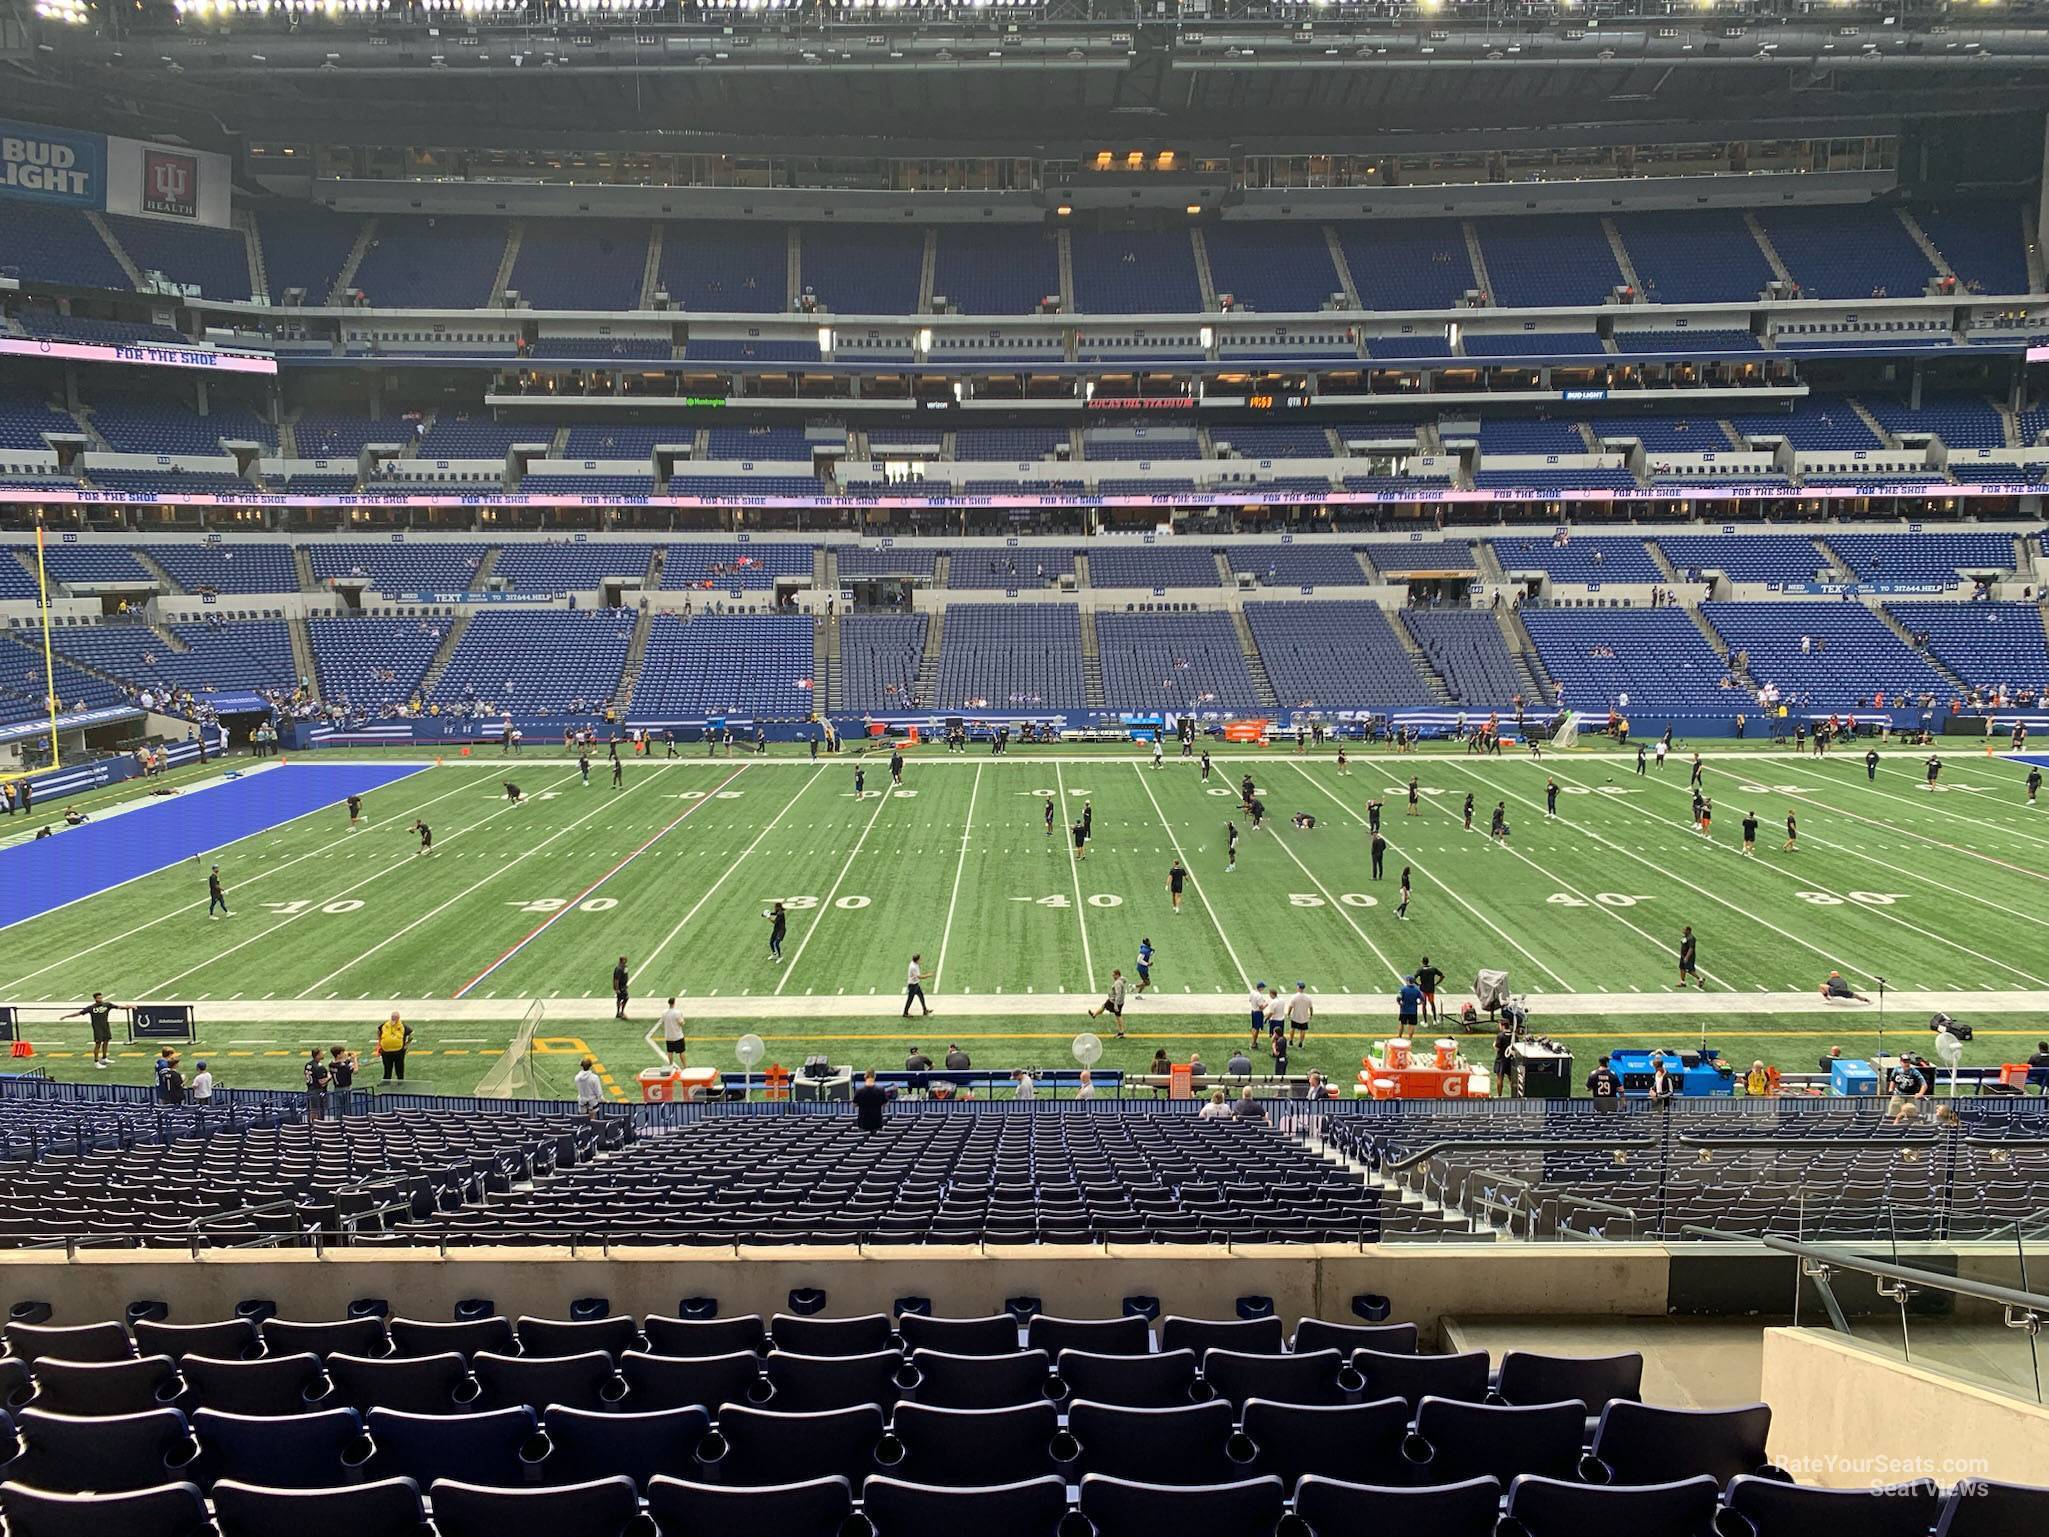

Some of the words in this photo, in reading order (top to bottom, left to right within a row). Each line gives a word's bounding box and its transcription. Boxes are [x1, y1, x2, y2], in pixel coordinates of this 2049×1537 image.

[2, 137, 75, 168] BUD
[0, 162, 89, 195] IGHT
[147, 200, 193, 215] HEALTH
[116, 348, 144, 361] FOR
[148, 351, 177, 363] THE
[181, 354, 217, 366] SHOE
[1583, 391, 1604, 400] LIGHT
[926, 401, 948, 410] verizon
[1613, 489, 1633, 498] FOR
[1635, 489, 1654, 498] THE
[1656, 489, 1681, 498] SHOE
[1732, 487, 1751, 496] FOR
[1754, 487, 1774, 496] THE
[1776, 487, 1801, 496] SHOE
[1856, 485, 1875, 495] FOR
[1877, 485, 1898, 495] THE
[1901, 485, 1927, 495] SHOE
[1981, 484, 2001, 494] FOR
[2003, 484, 2024, 494] THE
[78, 493, 100, 502] FOR
[104, 493, 126, 502] THE
[129, 493, 158, 502] SHOE
[1152, 495, 1169, 503] FOR
[1171, 495, 1190, 503] THE
[1192, 495, 1216, 503] SHOE
[1263, 493, 1281, 502] FOR
[1283, 493, 1301, 502] THE
[1304, 493, 1327, 502] SHOE
[1377, 491, 1396, 500] FOR
[1398, 491, 1417, 500] THE
[1419, 491, 1444, 500] SHOE
[1493, 490, 1512, 499] FOR
[1515, 490, 1534, 499] THE
[1536, 490, 1561, 499] SHOE
[216, 496, 237, 504] FOR
[239, 496, 259, 504] THE
[261, 496, 287, 504] SHOE
[339, 496, 359, 504] FOR
[361, 496, 381, 504] THE
[383, 496, 409, 504] SHOE
[461, 496, 481, 504] FOR
[483, 496, 503, 504] THE
[505, 496, 530, 504] SHOE
[581, 496, 601, 504] FOR
[603, 496, 622, 504] THE
[624, 496, 649, 504] SHOE
[700, 497, 718, 505] FOR
[720, 497, 740, 505] THE
[742, 497, 766, 505] SHOE
[815, 497, 832, 505] FOR
[835, 497, 853, 505] THE
[855, 497, 880, 505] SHOE
[928, 497, 946, 505] FOR
[948, 497, 966, 505] THE
[968, 497, 992, 505] SHOE
[1040, 496, 1057, 505] FOR
[1059, 496, 1078, 505] THE
[1079, 496, 1104, 505] SHOE
[433, 593, 463, 603] TEXT
[1442, 1077, 1462, 1097] G
[1598, 1081, 1611, 1096] 29
[647, 1084, 663, 1100] G
